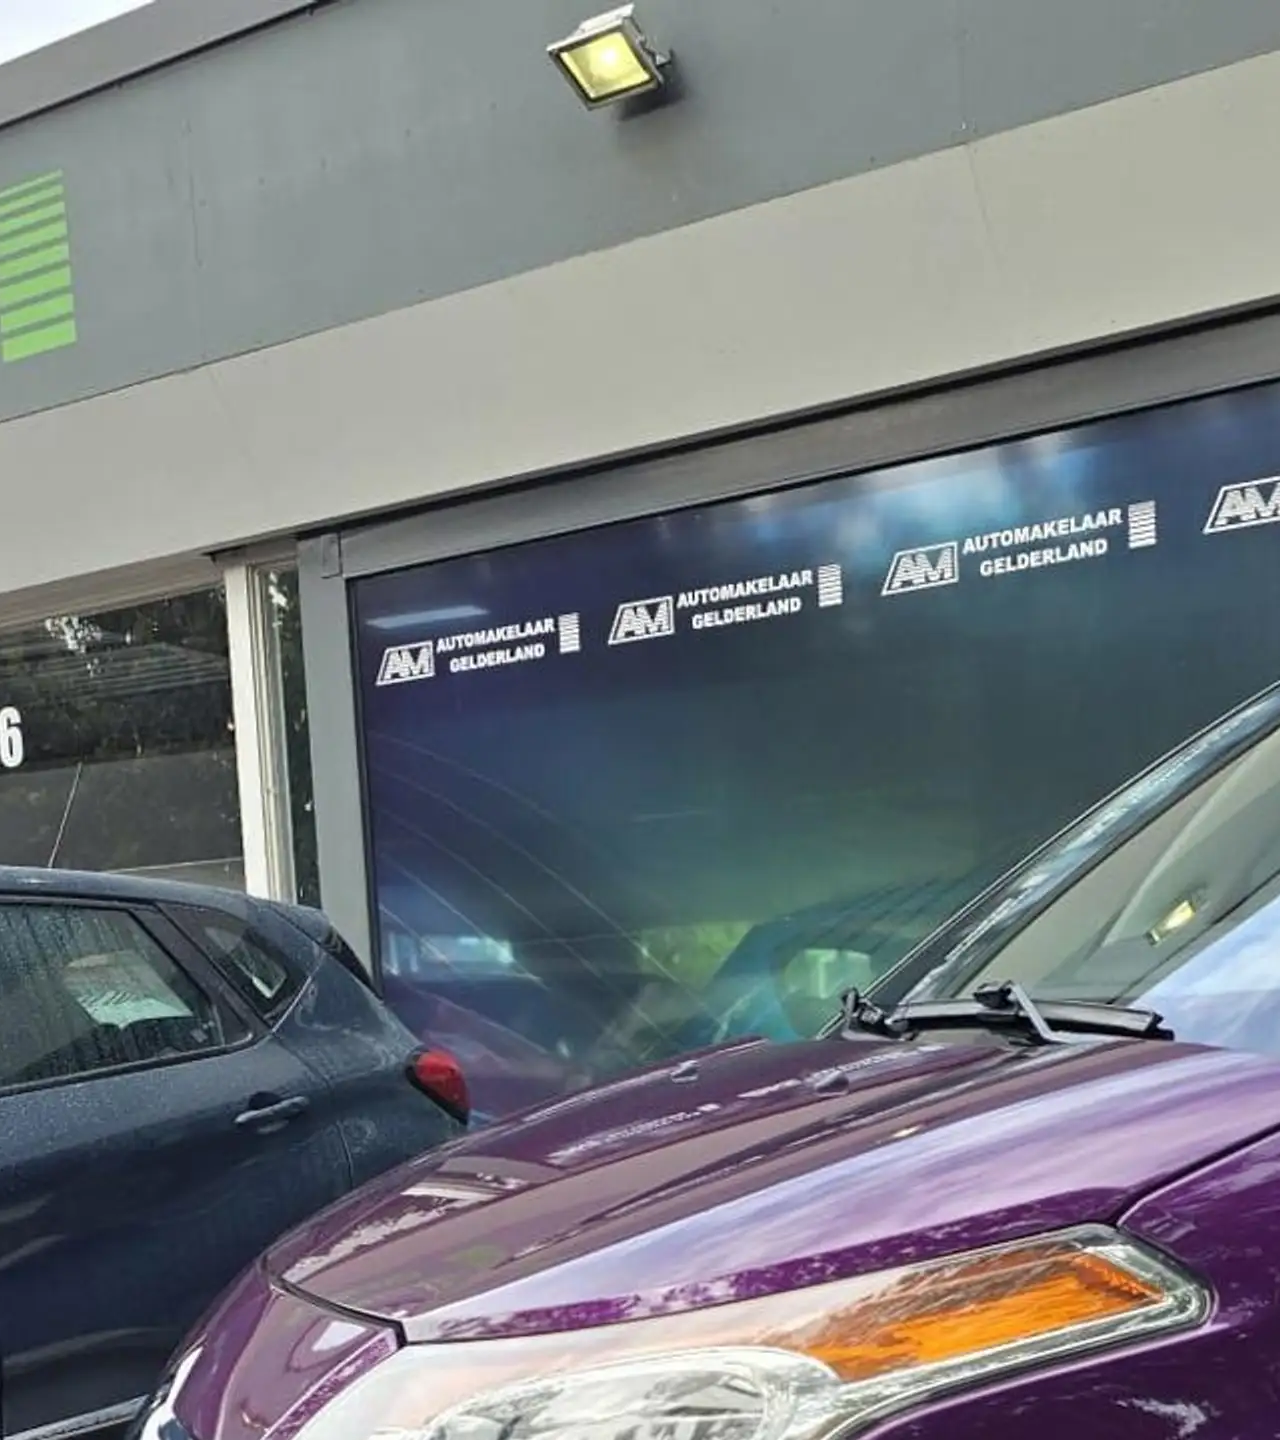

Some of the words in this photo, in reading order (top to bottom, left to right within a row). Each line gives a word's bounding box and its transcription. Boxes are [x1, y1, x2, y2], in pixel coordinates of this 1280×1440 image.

[962, 508, 1122, 554] AUTOMAKELAAR
[979, 538, 1108, 578] GELDERLAND
[676, 570, 813, 609] AUTOMAKELAAR
[691, 597, 803, 630] GELDERLAND
[435, 617, 555, 653] AUTOMAKELAAR
[448, 643, 546, 673] GELDERLAND
